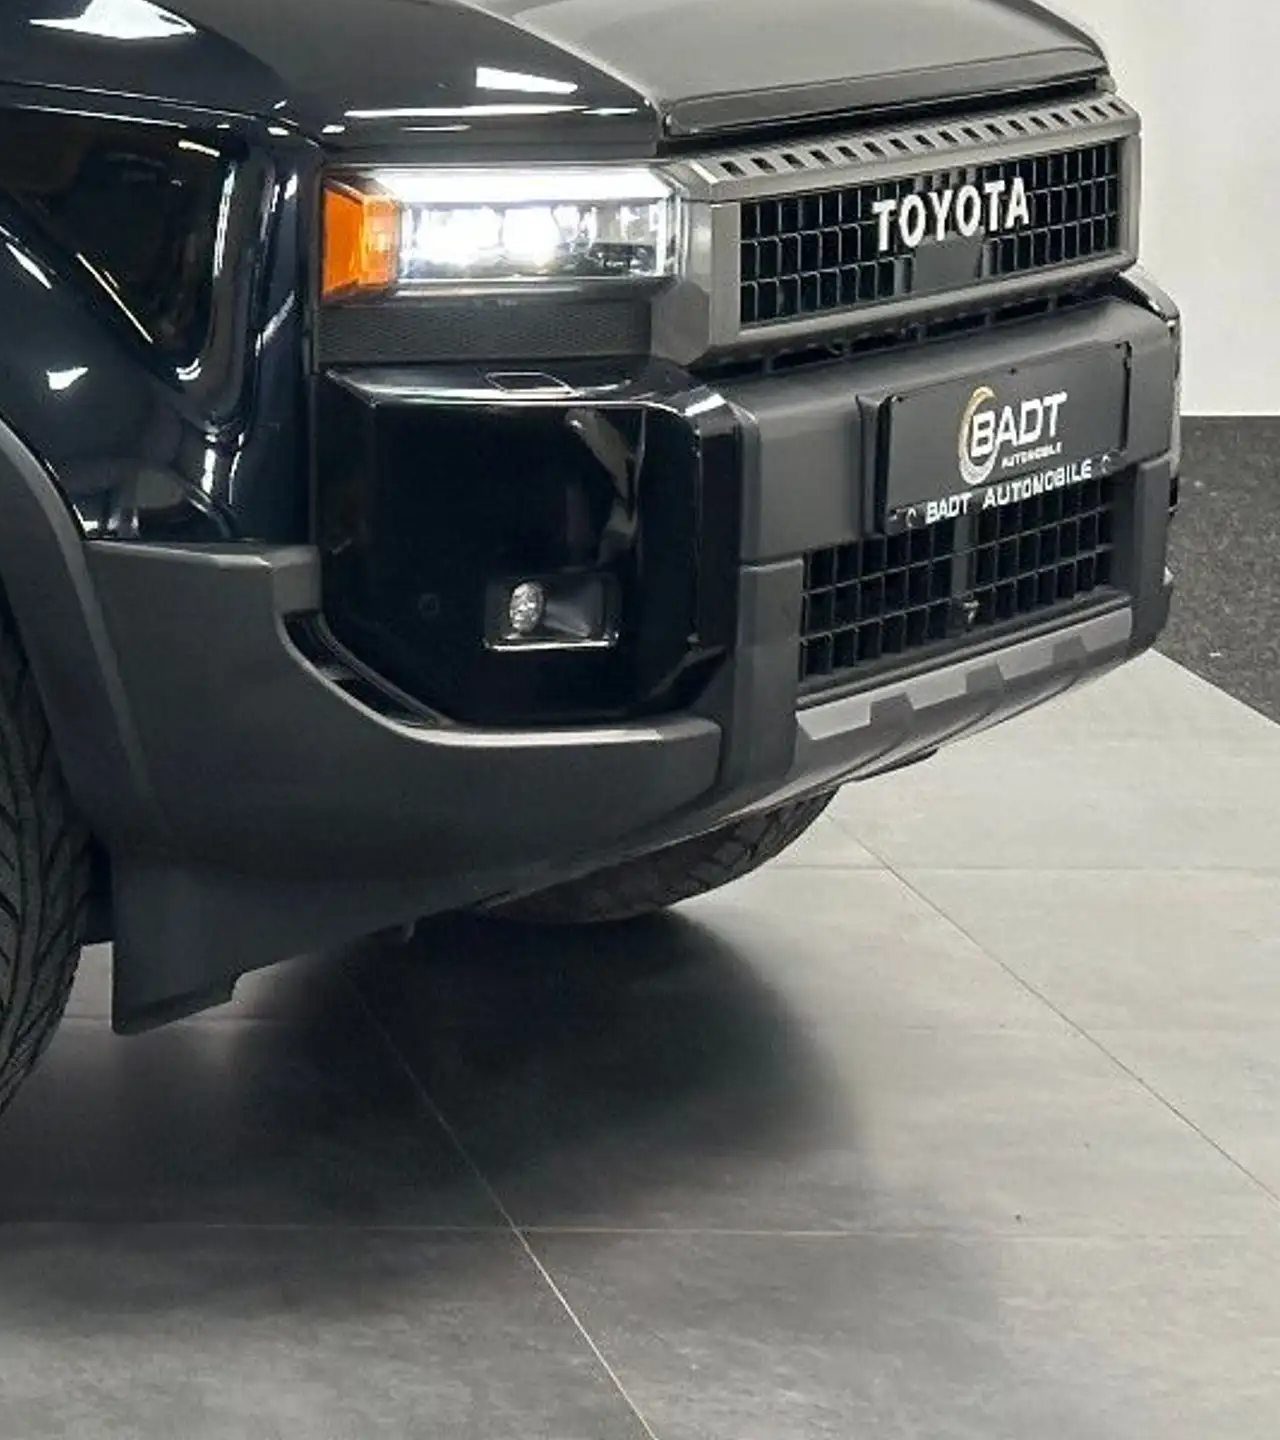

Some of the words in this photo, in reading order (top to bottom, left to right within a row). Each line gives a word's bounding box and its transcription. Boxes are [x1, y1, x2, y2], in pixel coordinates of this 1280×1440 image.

[871, 176, 1030, 252] TOYOTA
[969, 390, 1069, 459] BADT
[924, 491, 974, 525] BADT
[982, 459, 1093, 510] AUTOMOBILE
